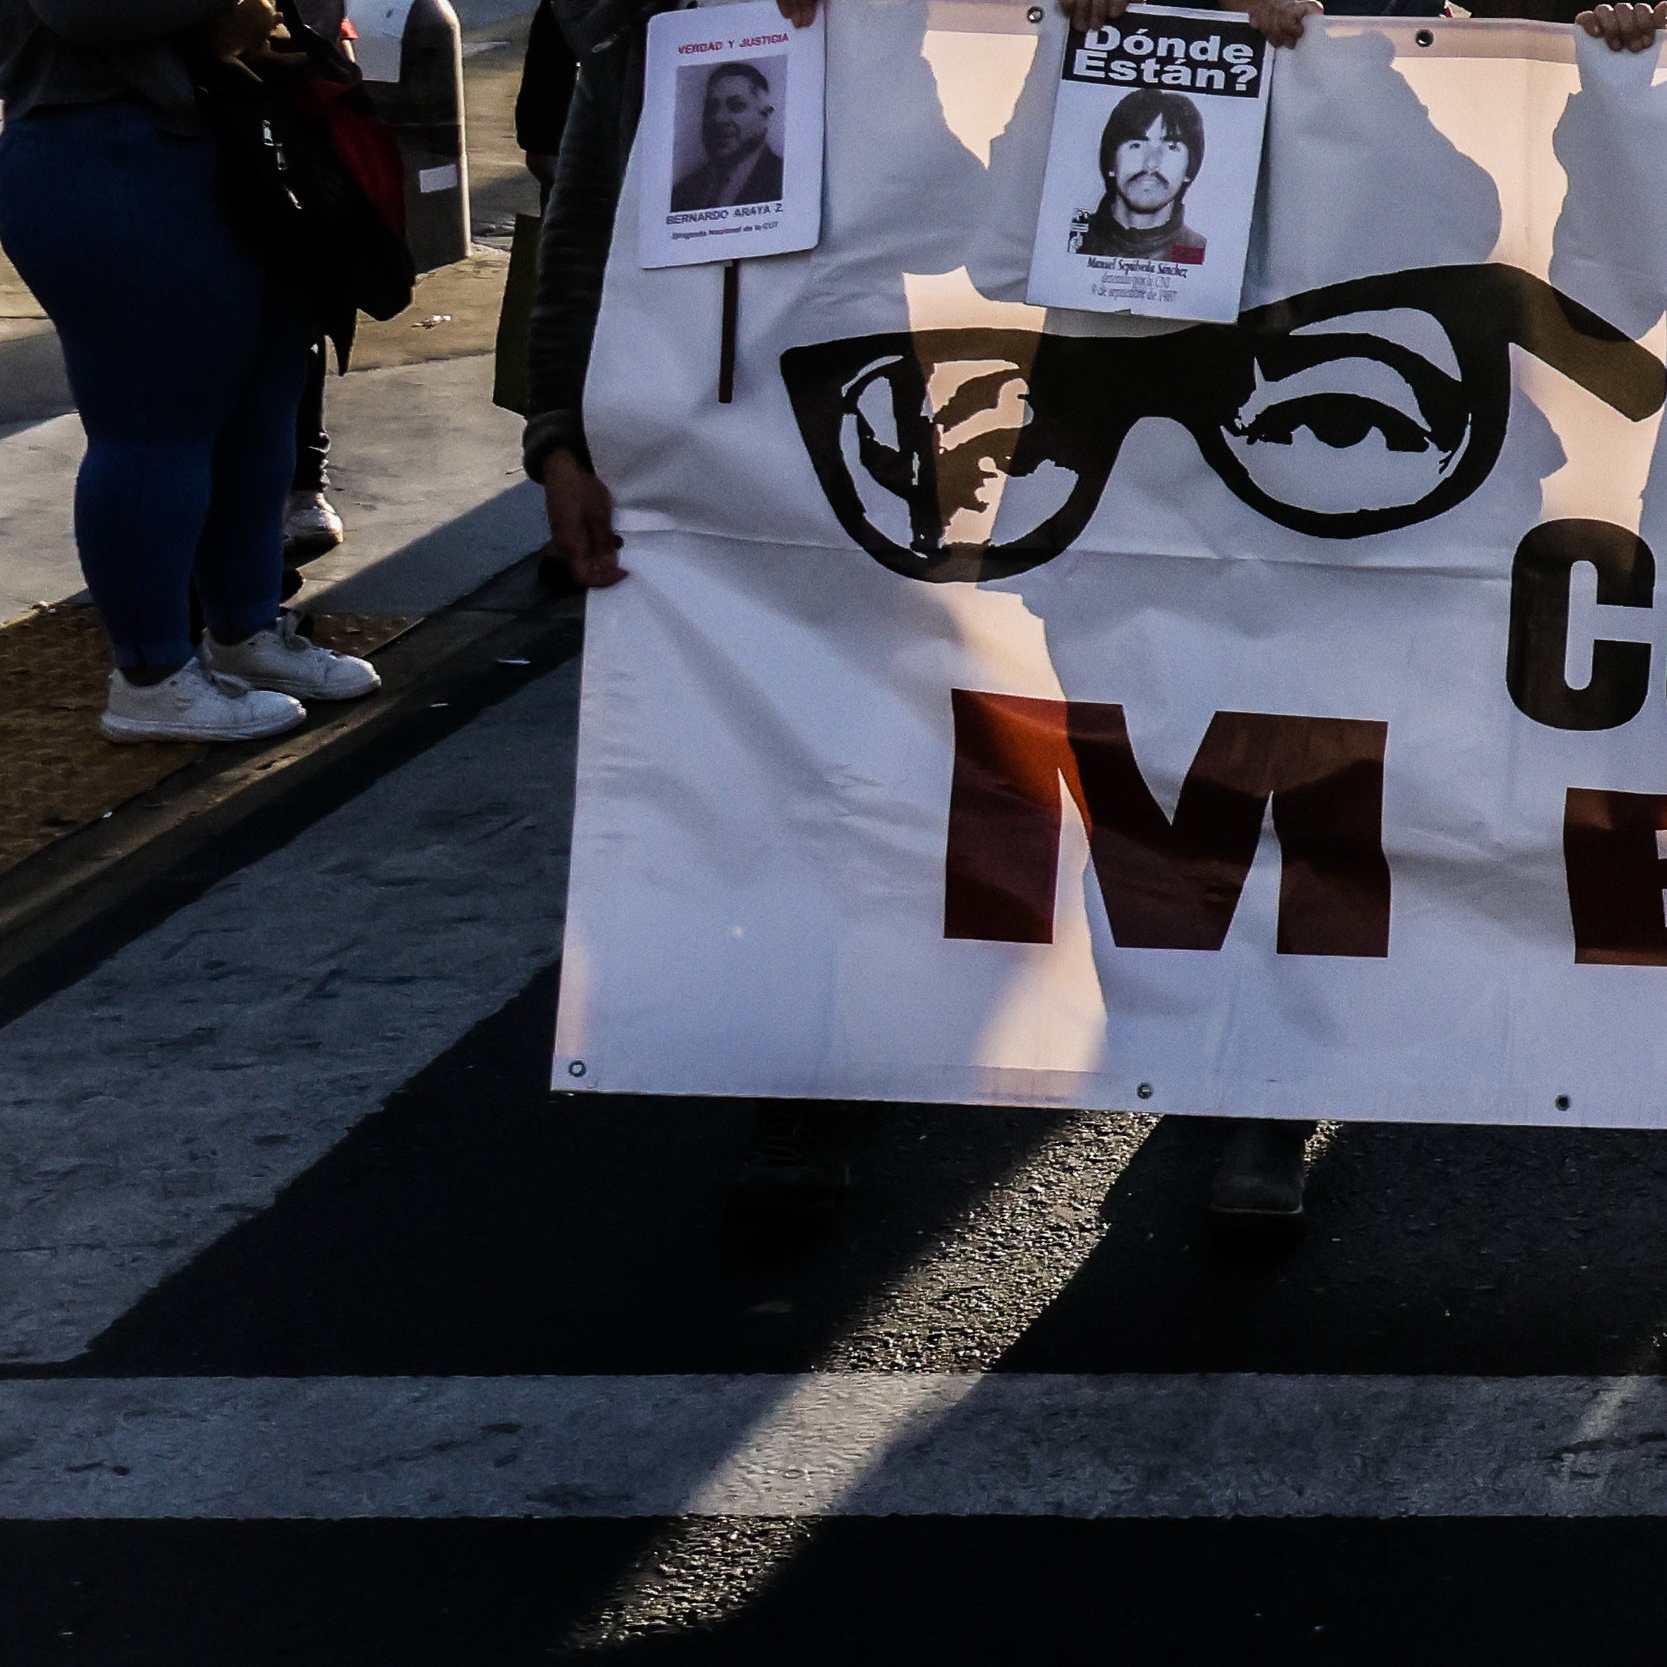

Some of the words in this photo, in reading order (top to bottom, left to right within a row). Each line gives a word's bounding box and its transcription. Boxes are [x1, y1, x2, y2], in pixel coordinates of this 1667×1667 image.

[678, 41, 723, 54] VERDAD
[728, 40, 735, 48] Y
[739, 33, 789, 47] JUSTICIA
[1084, 24, 1254, 64] Dónde
[1073, 49, 1258, 91] Están?
[666, 210, 729, 225] BERNARDO
[733, 205, 770, 217] ARAYA
